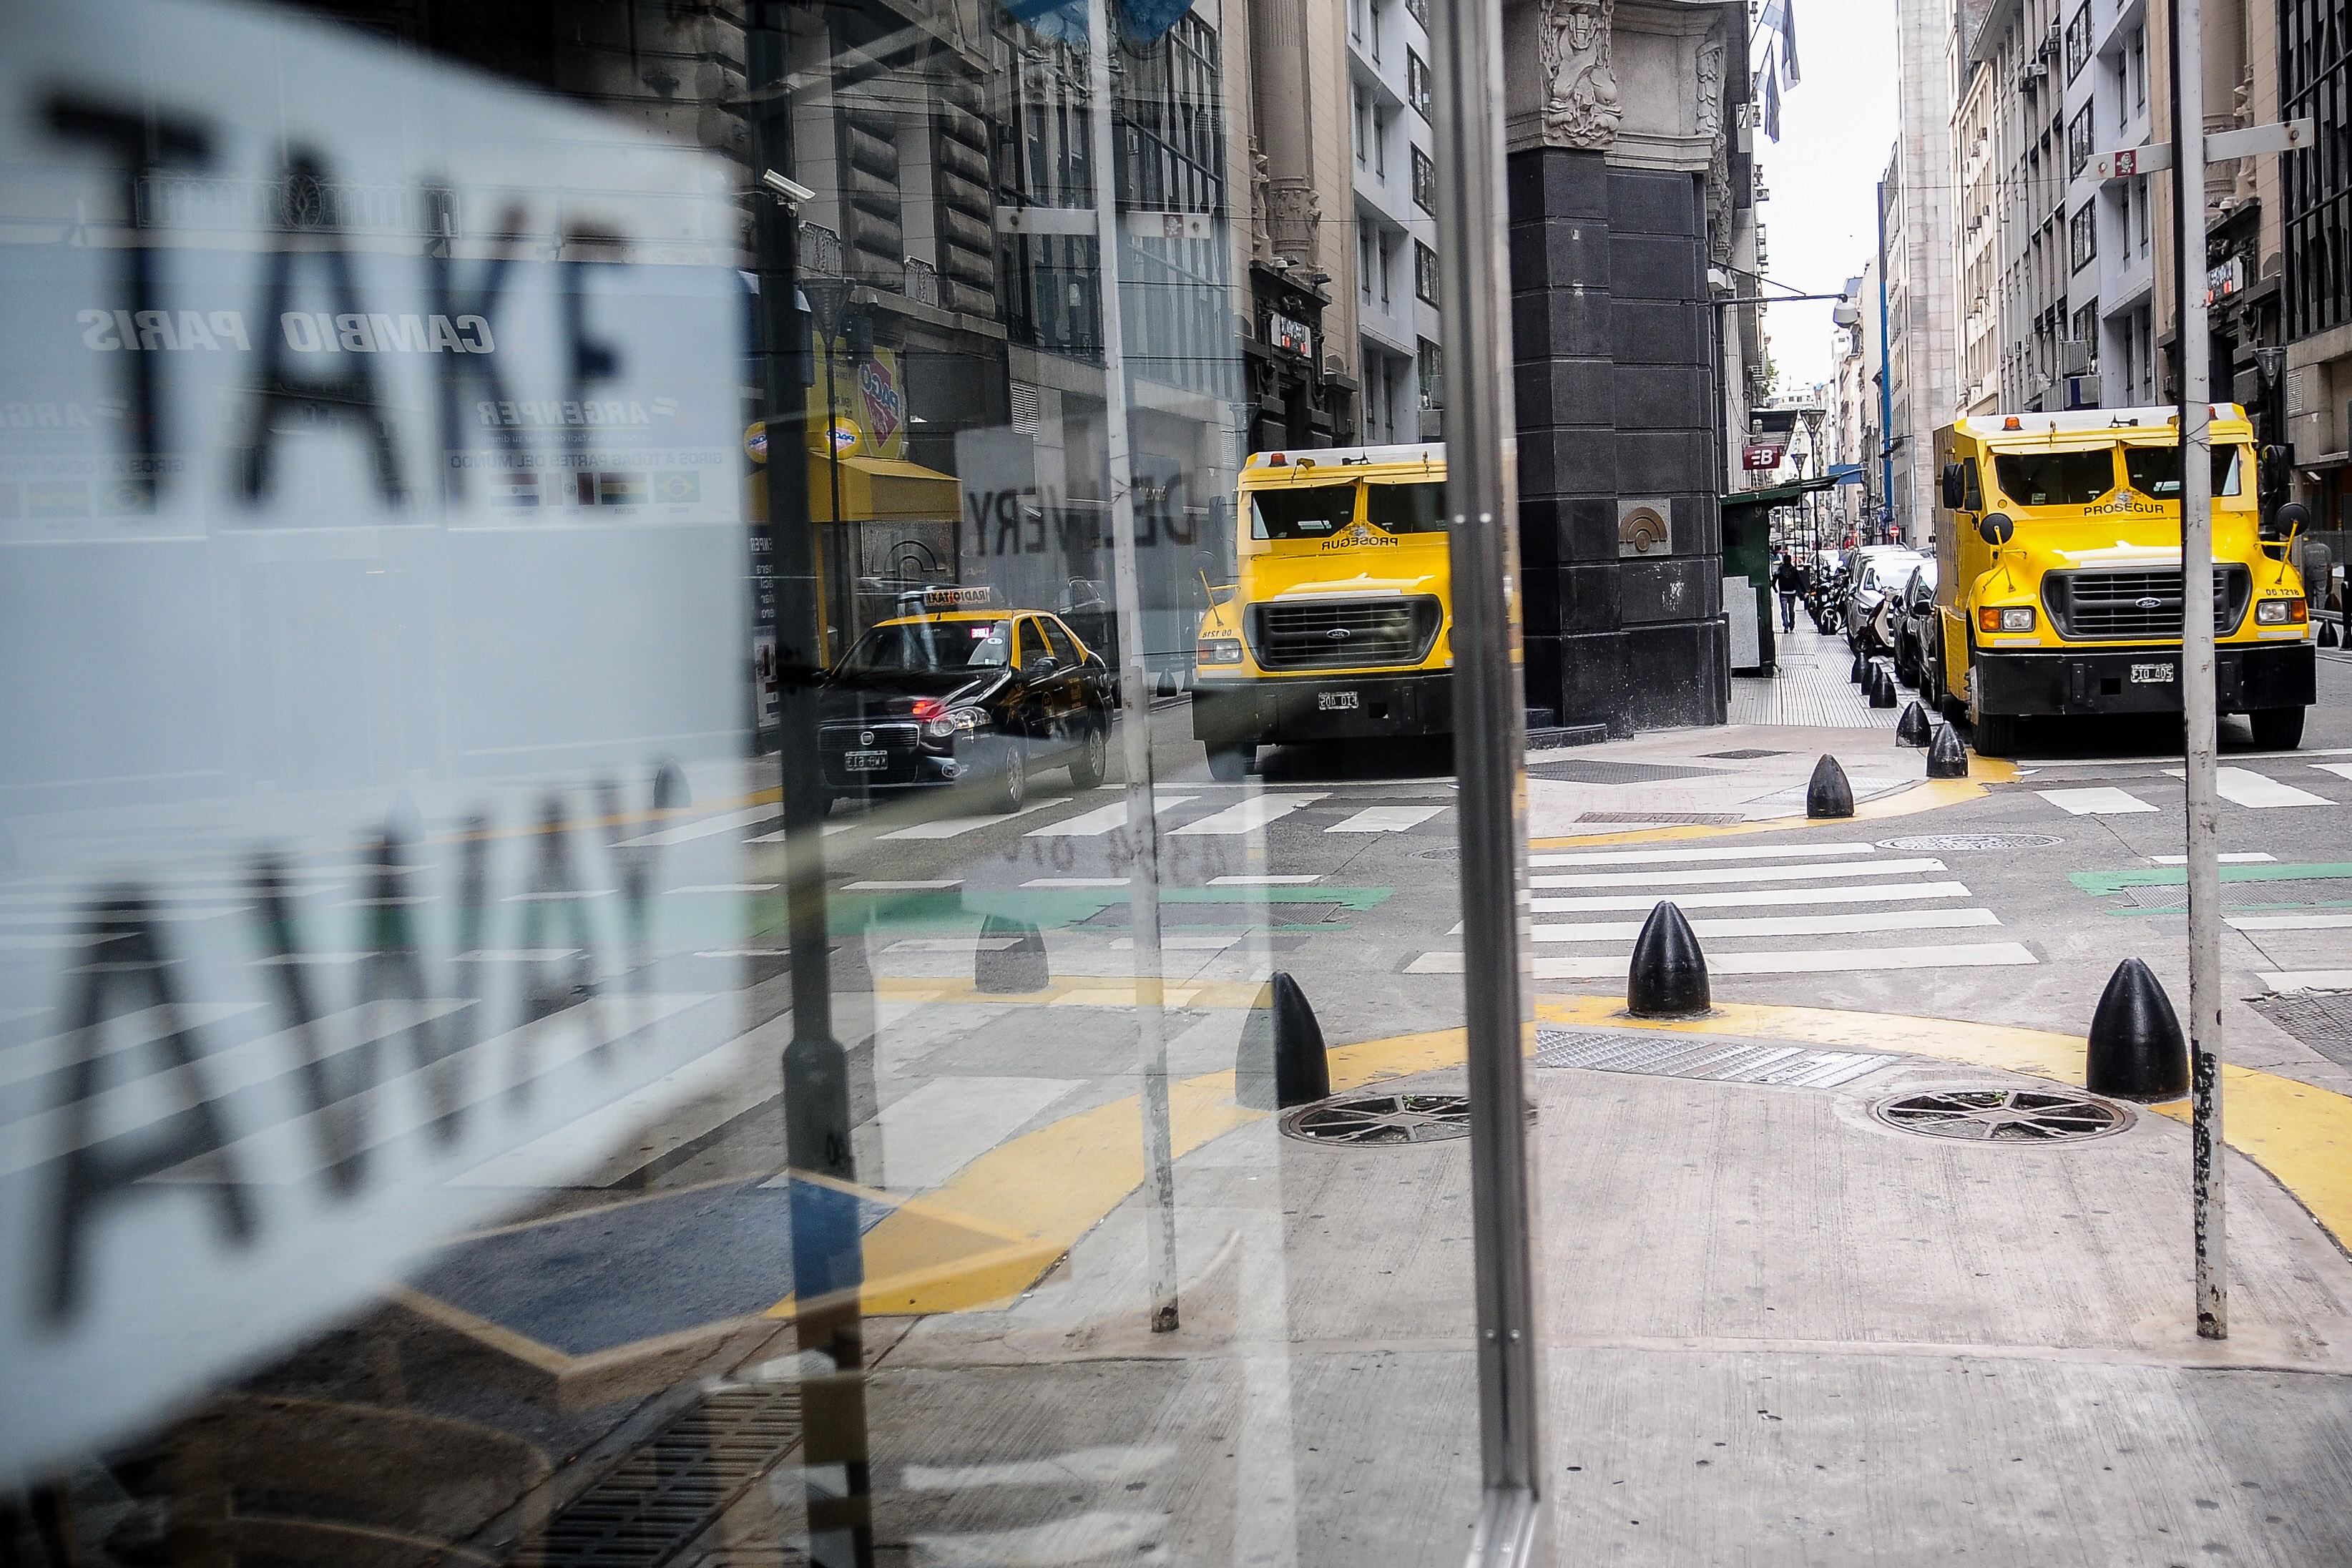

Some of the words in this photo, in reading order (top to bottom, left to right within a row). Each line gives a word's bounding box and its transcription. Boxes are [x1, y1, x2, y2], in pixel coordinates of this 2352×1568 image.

[41, 84, 633, 516] TAKE
[2084, 503, 2165, 516] PROSEGUR
[39, 773, 665, 1338] AWAY
